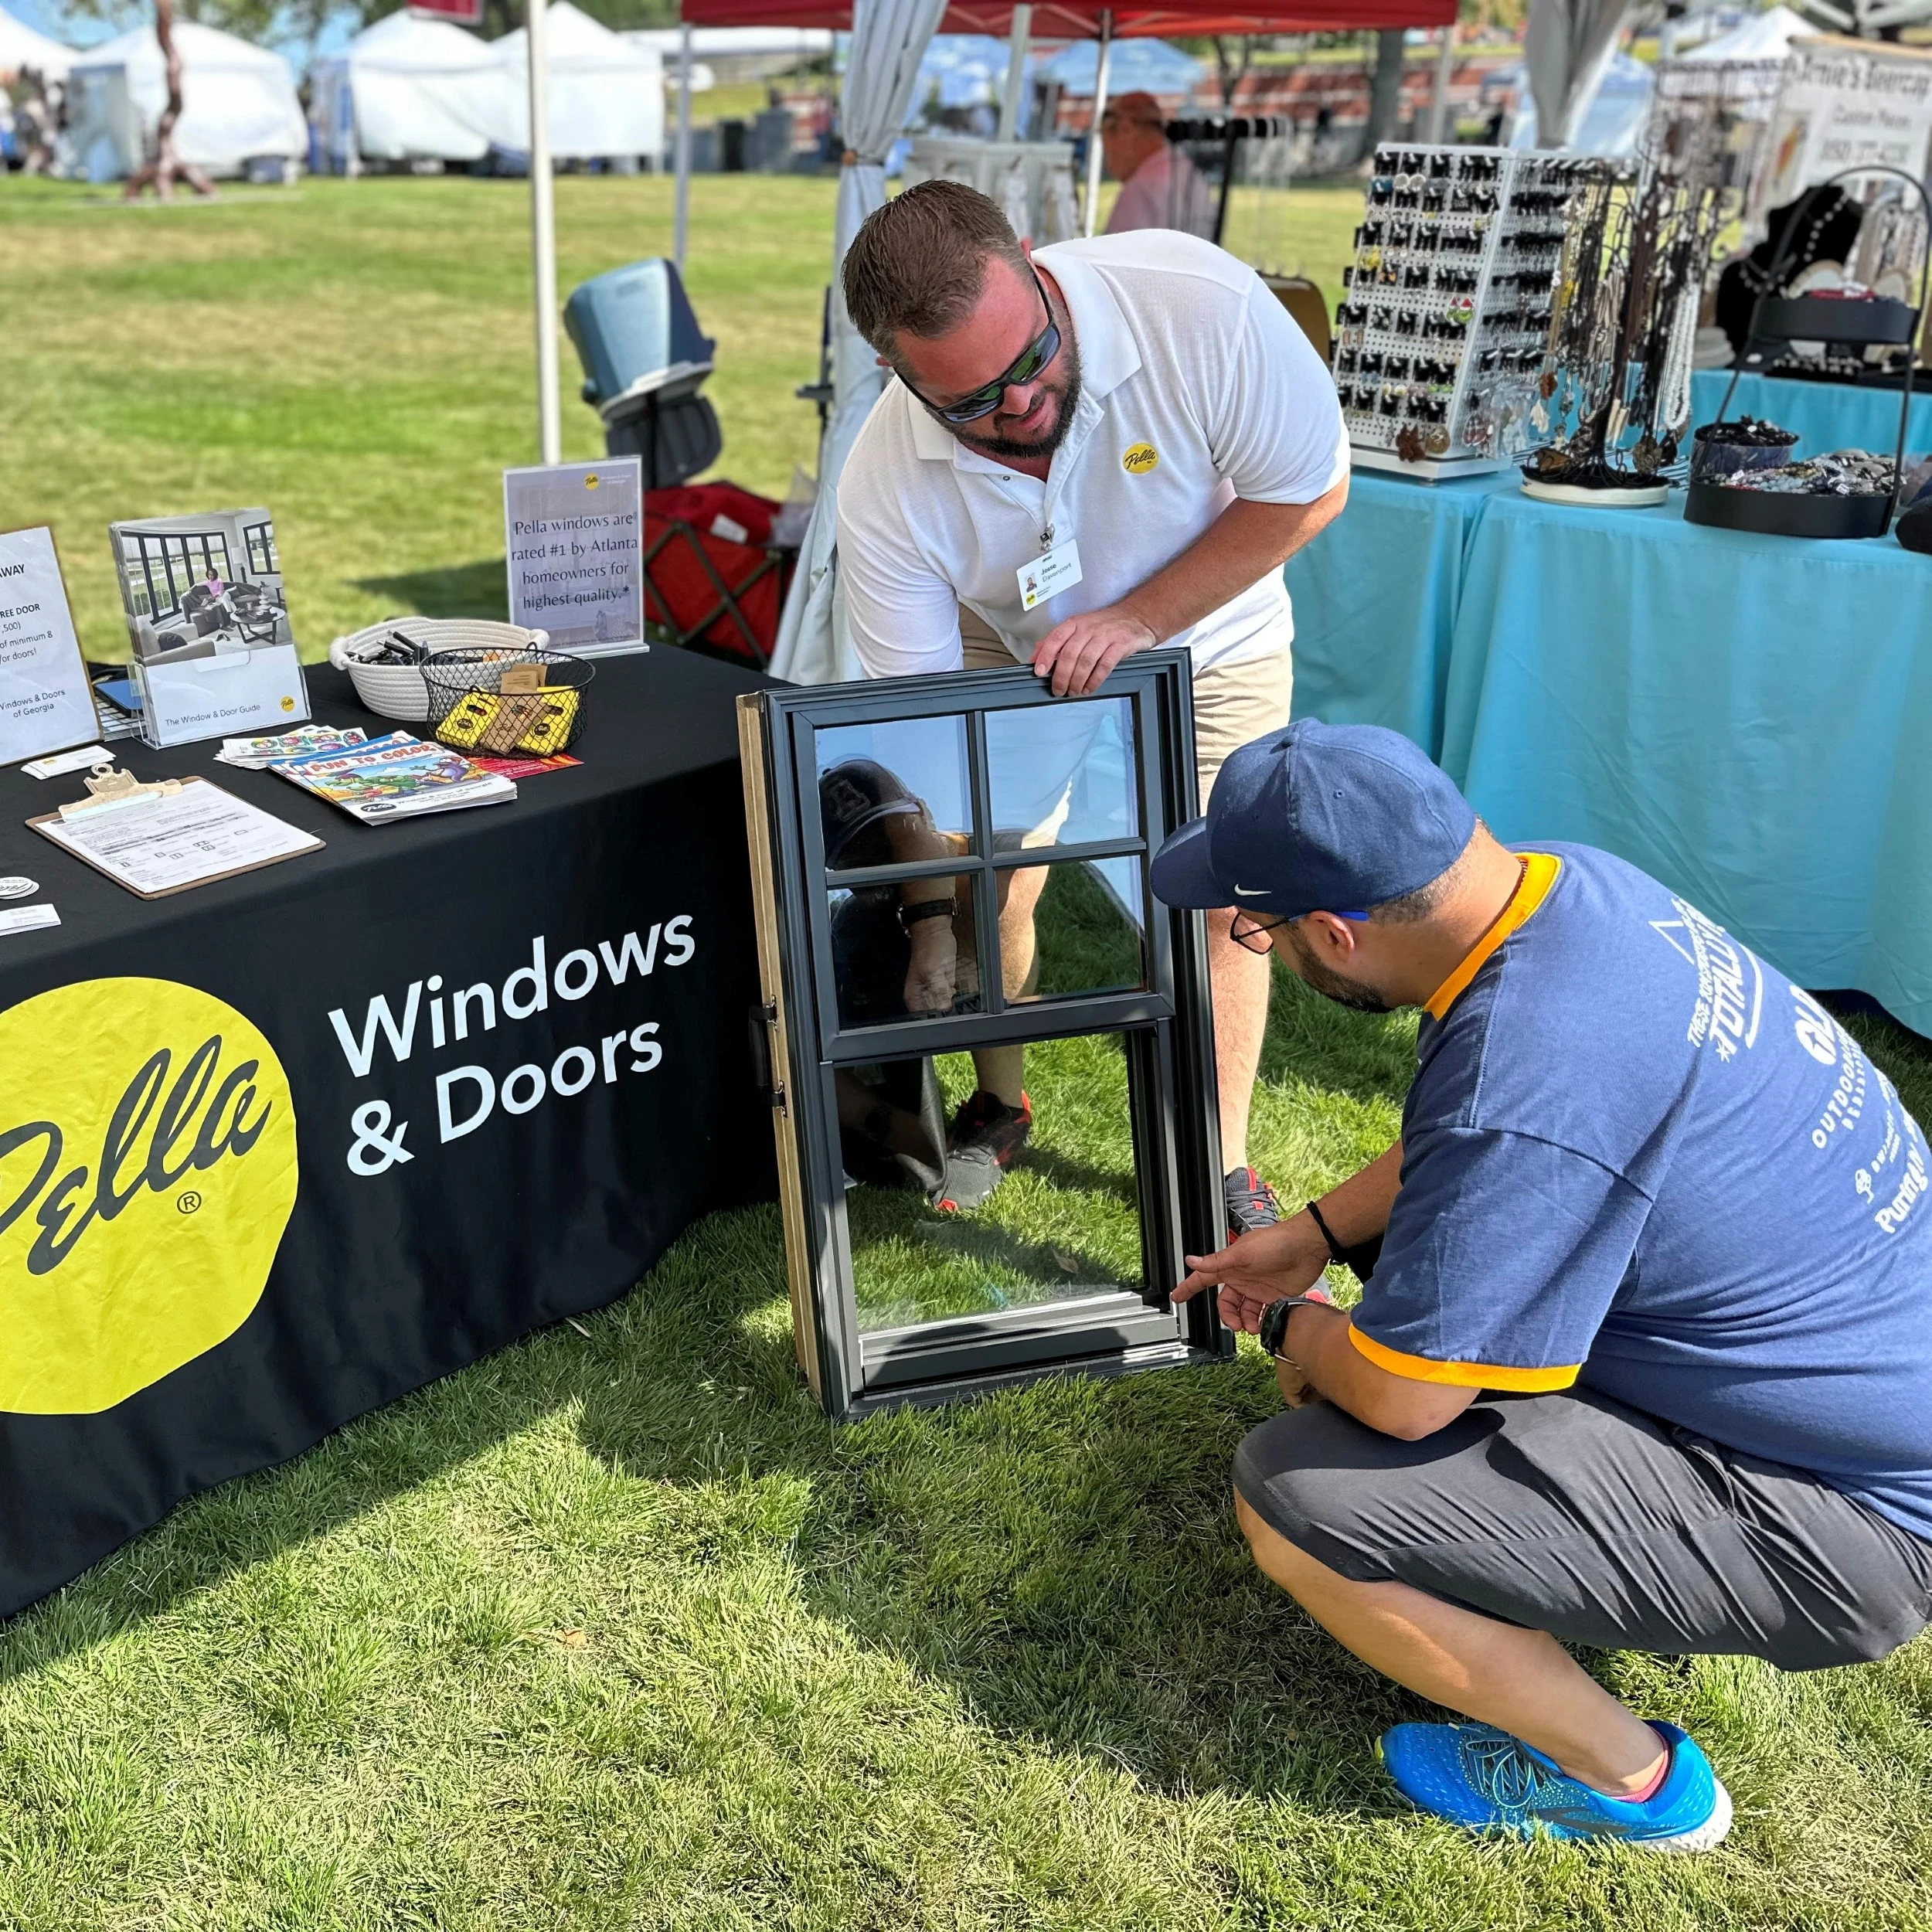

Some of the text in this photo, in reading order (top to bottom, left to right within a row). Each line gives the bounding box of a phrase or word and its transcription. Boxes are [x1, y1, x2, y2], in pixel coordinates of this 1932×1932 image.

[1124, 449, 1156, 470] Pella
[515, 514, 634, 536] Pella windows are
[512, 538, 638, 561] rated #1 by Atlanta
[522, 561, 630, 585] homeowners for
[1041, 563, 1057, 575] Jesse
[1042, 563, 1072, 583] Davenport
[15, 604, 41, 615] DOOR
[523, 594, 570, 611] highest
[0, 640, 8, 649] of
[10, 633, 46, 648] minimum
[12, 648, 37, 660] doors!
[35, 694, 41, 702] &
[42, 689, 66, 700] Doors
[13, 702, 54, 718] of Georgia
[181, 713, 212, 723] Window
[219, 708, 238, 717] Door
[239, 704, 261, 713] Guide
[310, 760, 348, 772] FUN
[351, 756, 376, 764] TO
[380, 743, 430, 760] COLOR
[362, 803, 393, 812] Pella
[328, 913, 696, 1079] Windows
[1688, 997, 1711, 1048] THESE
[346, 1021, 663, 1176] & Doors
